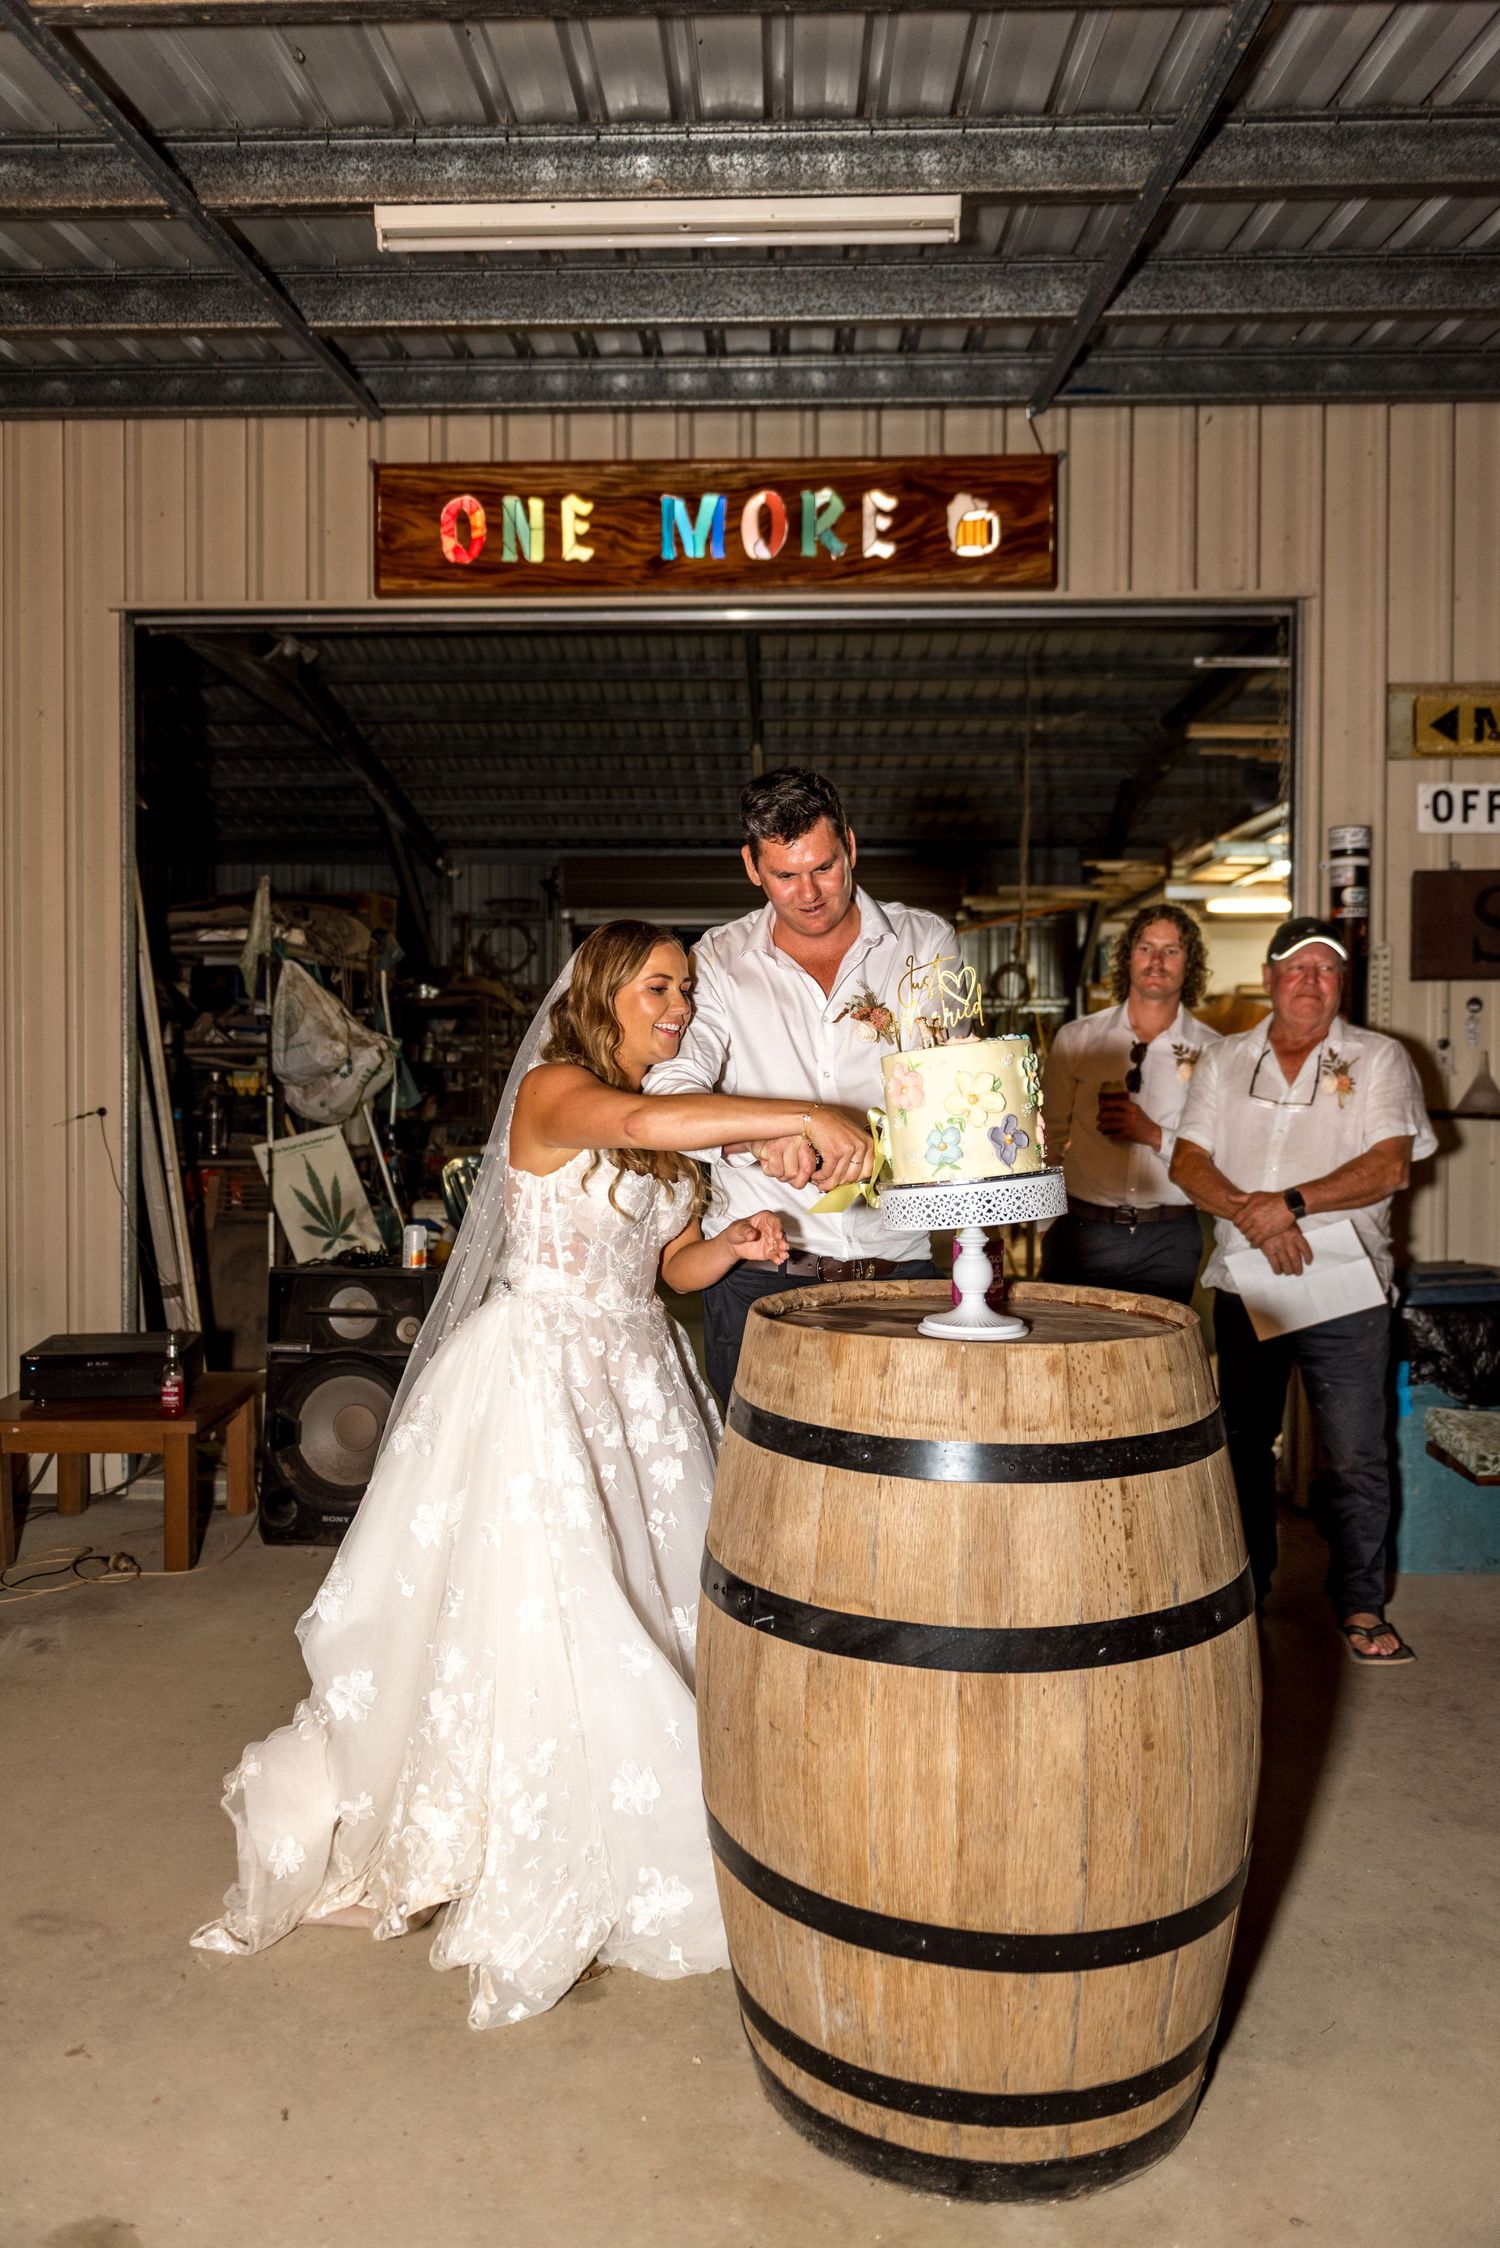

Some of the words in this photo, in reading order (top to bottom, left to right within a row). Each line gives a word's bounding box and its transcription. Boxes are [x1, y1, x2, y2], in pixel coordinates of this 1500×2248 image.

[440, 494, 595, 563] ONE
[660, 487, 898, 561] MORE
[898, 953, 955, 1008] Just
[321, 1514, 350, 1523] SONY
